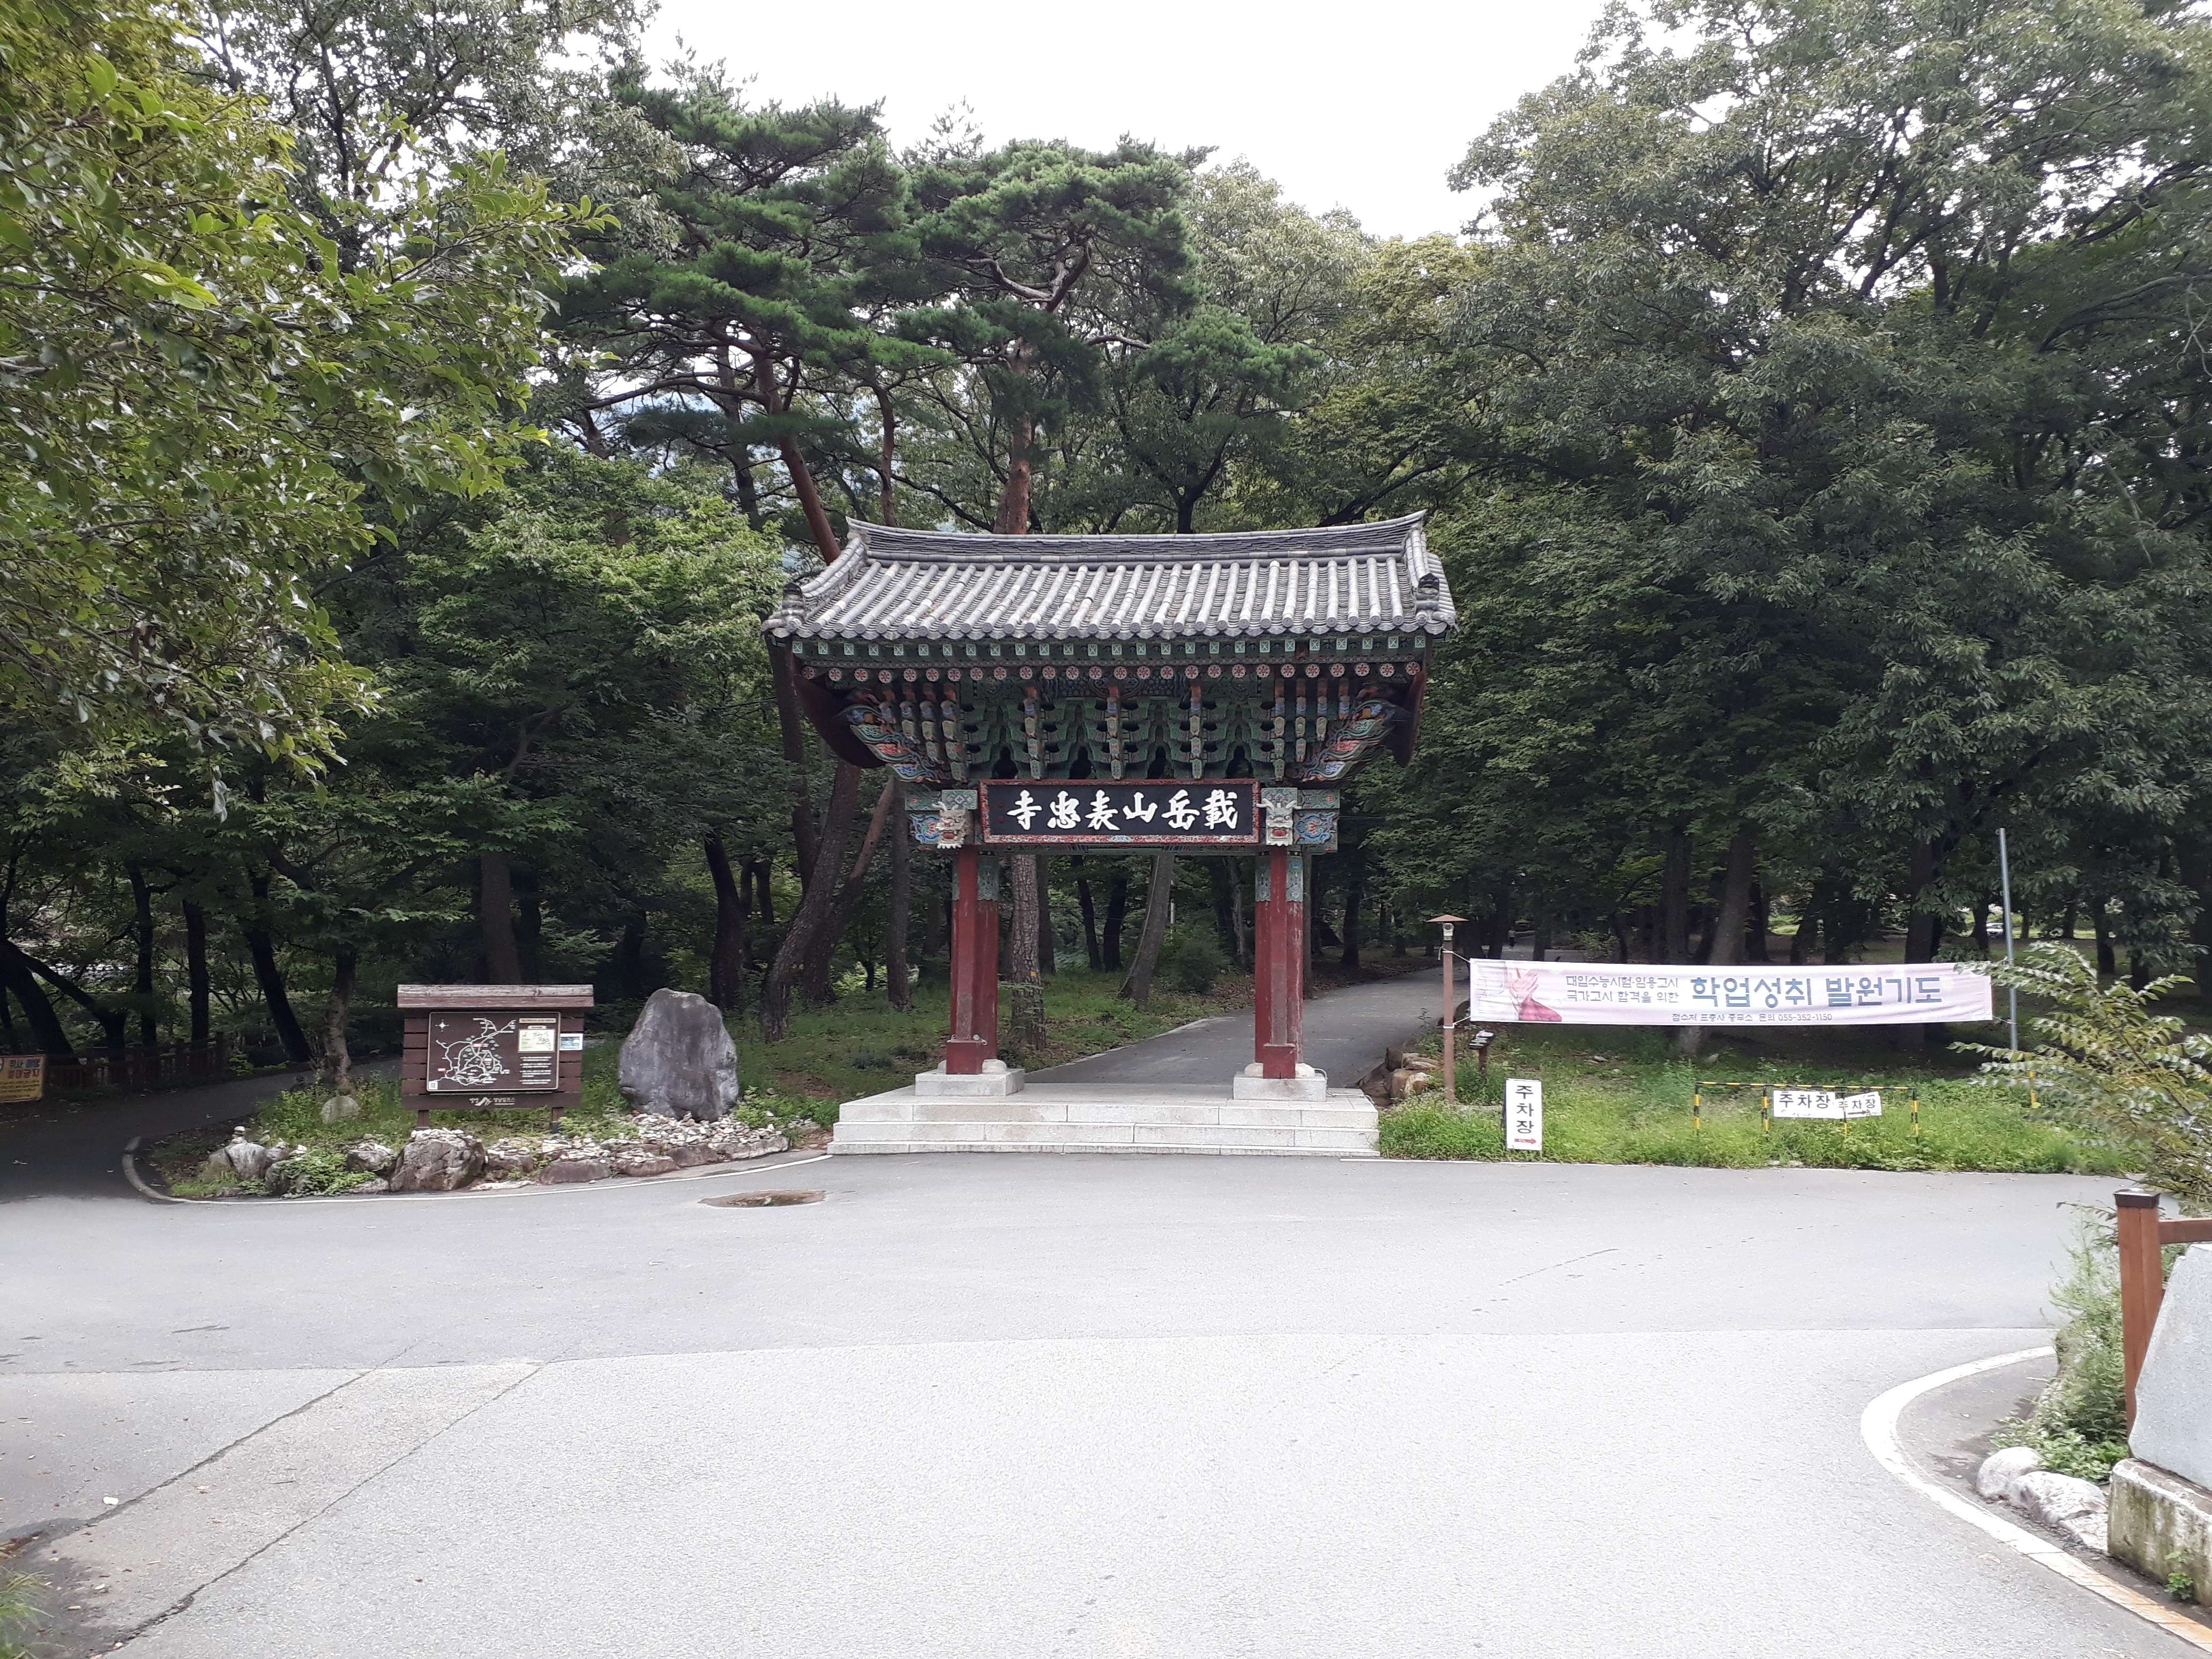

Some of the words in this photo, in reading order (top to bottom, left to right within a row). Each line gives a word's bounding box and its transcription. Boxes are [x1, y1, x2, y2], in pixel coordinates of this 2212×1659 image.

[1567, 990, 1612, 1002] 국가고시
[1617, 991, 1651, 1003] 합격을
[1657, 992, 1679, 1003] 위한
[1690, 977, 1812, 1008] 학업성취
[1826, 977, 1942, 1007] 발원기도
[1778, 1013, 1833, 1021] 055-352-1150
[1778, 1094, 1831, 1109] 주차장
[1515, 1085, 1535, 1134] 주차장
